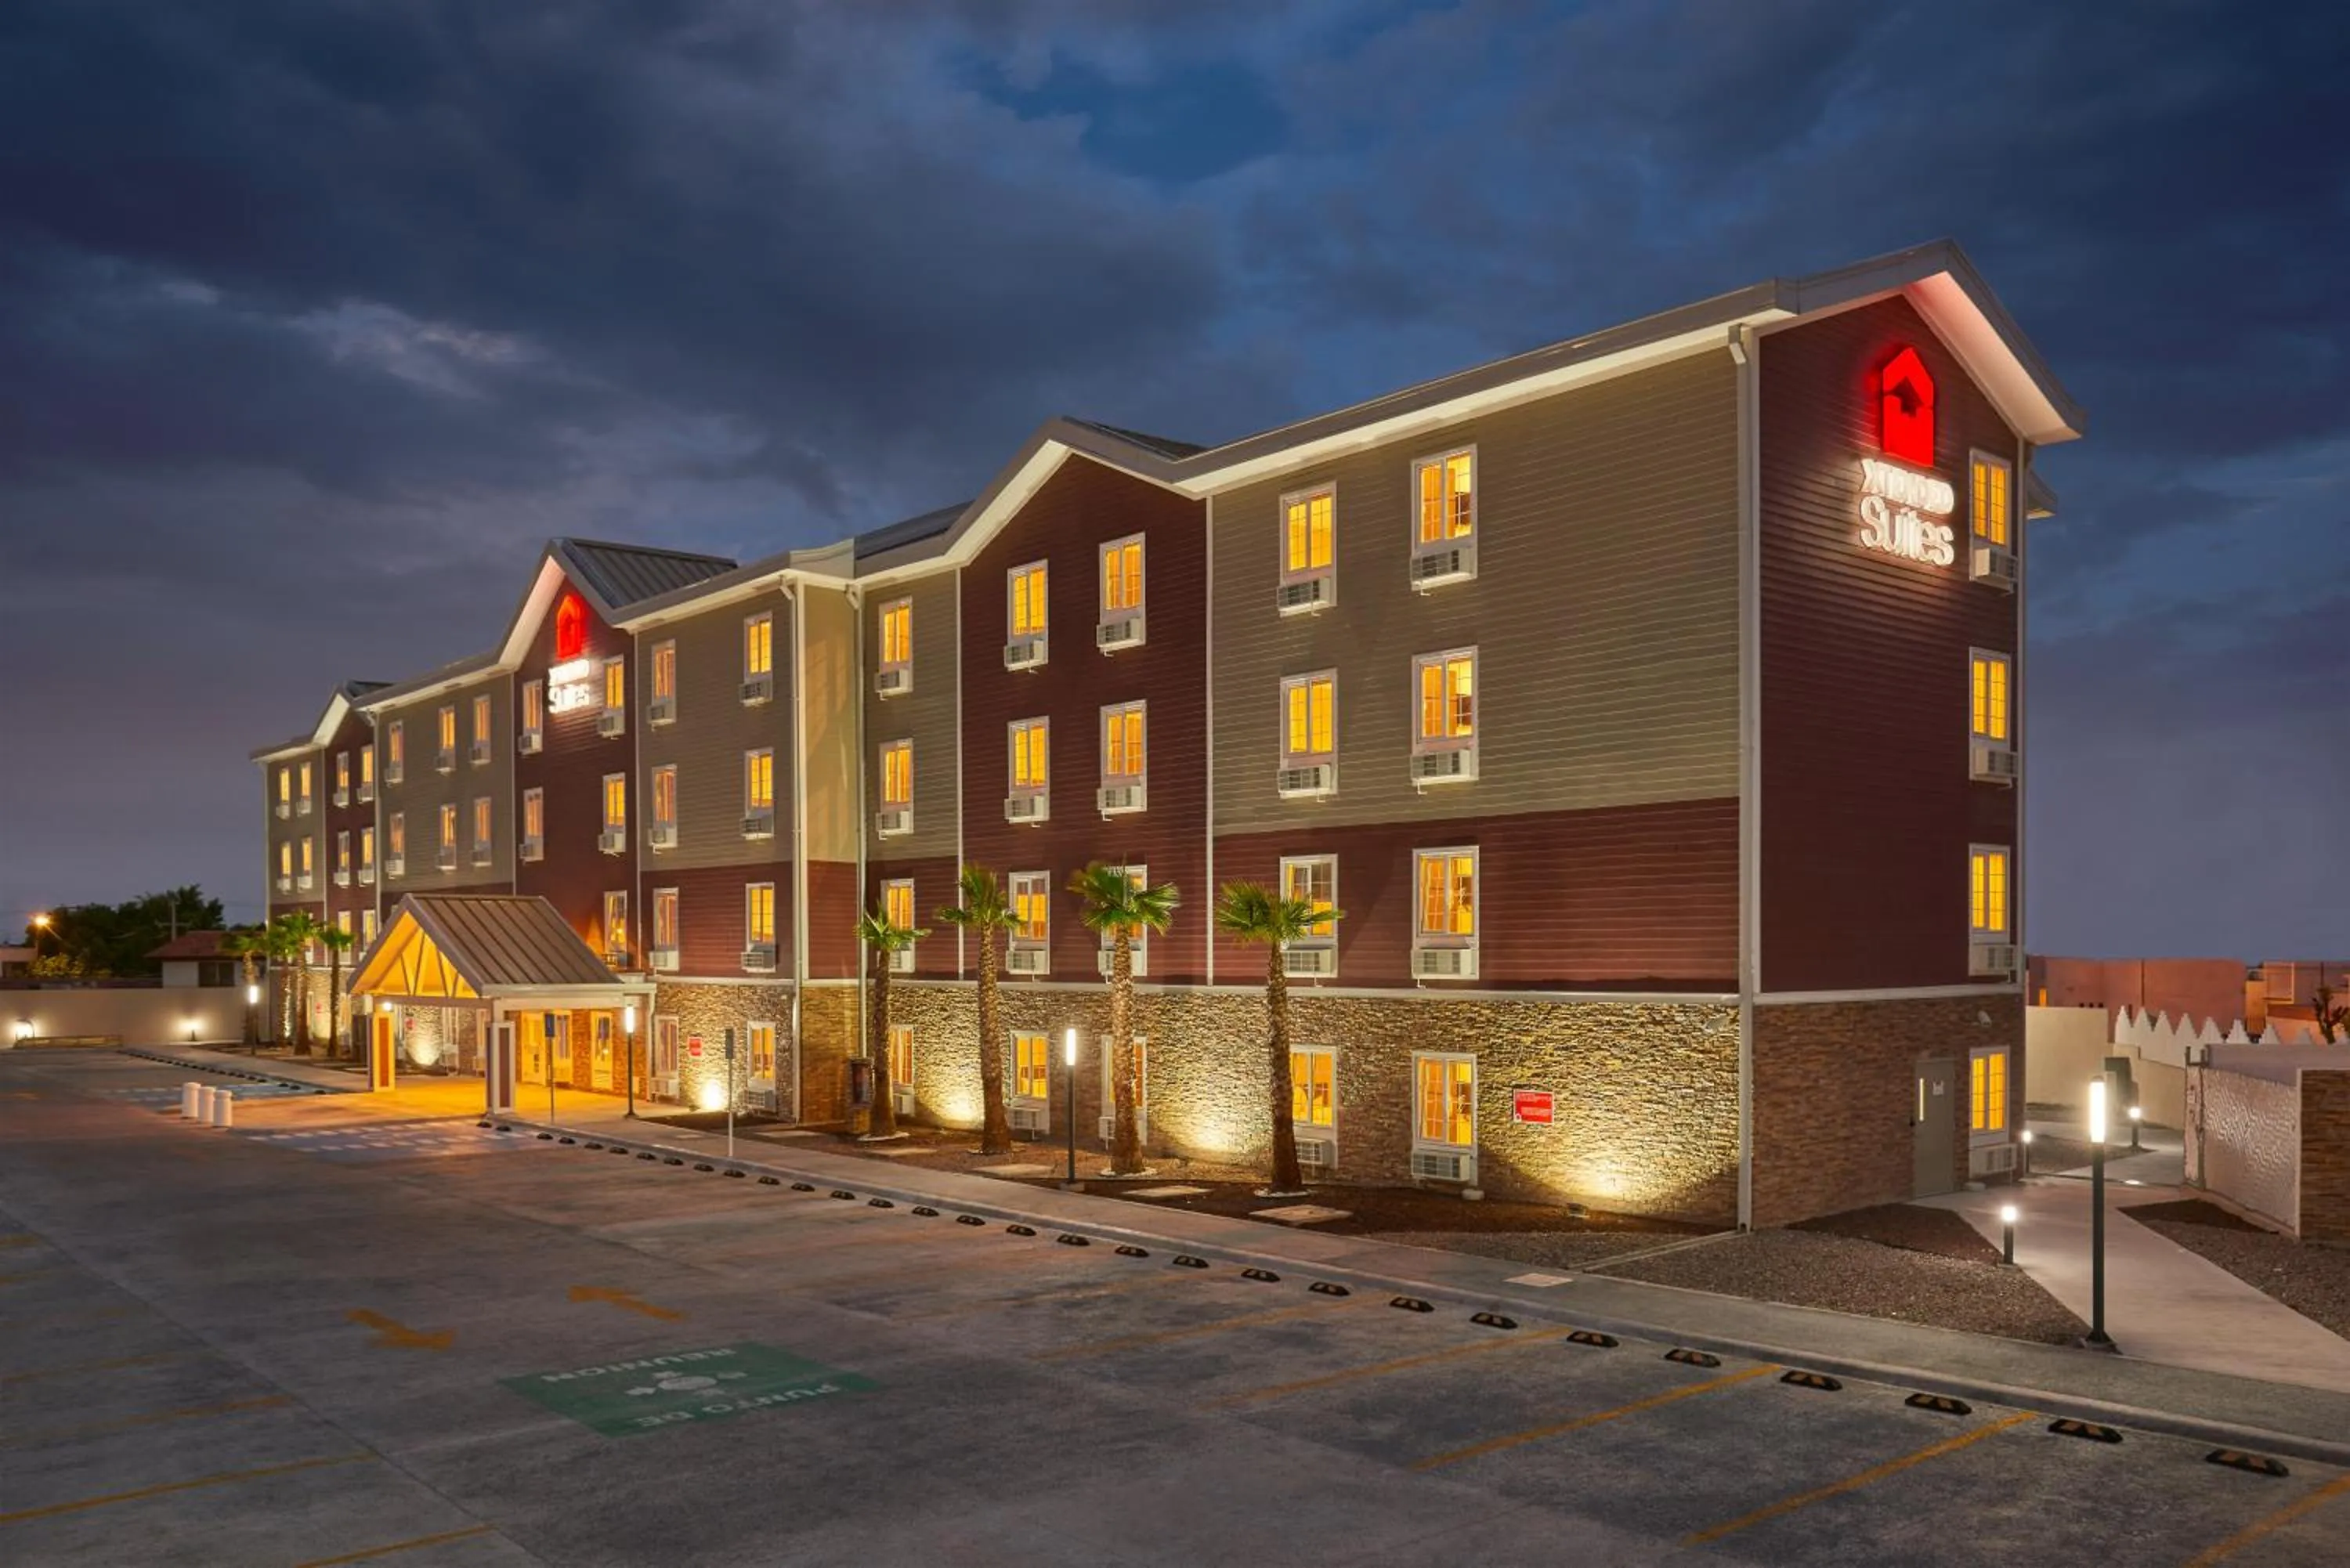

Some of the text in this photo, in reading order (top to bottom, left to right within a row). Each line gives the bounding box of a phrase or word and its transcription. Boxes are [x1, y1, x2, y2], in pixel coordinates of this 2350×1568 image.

[1860, 495, 1954, 566] Suites
[634, 1383, 841, 1427] PUNTO DE
